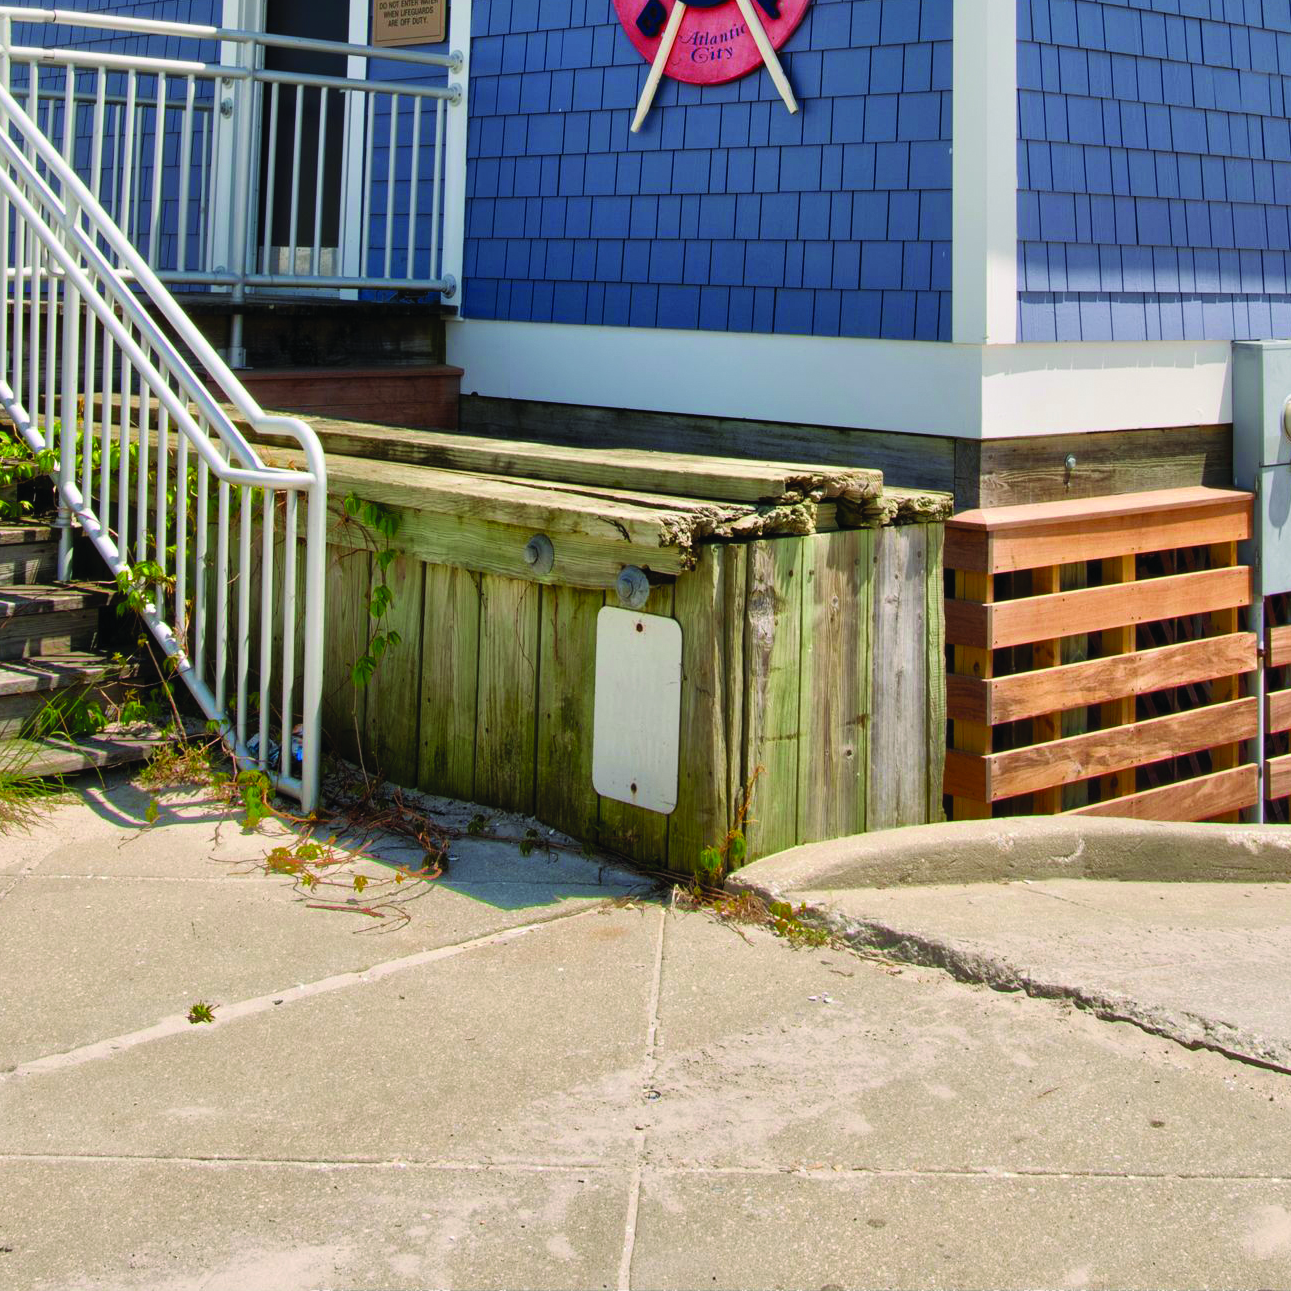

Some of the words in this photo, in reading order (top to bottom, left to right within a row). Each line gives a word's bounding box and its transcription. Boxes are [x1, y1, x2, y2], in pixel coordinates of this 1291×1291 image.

[379, 2, 388, 10] DO
[389, 0, 399, 8] NOT
[384, 10, 399, 19] WHEN
[400, 6, 434, 17] LIFEGUARDS
[388, 19, 399, 27] ARE
[400, 17, 411, 26] OFF
[678, 23, 746, 46] Atlantic
[691, 46, 733, 63] City
